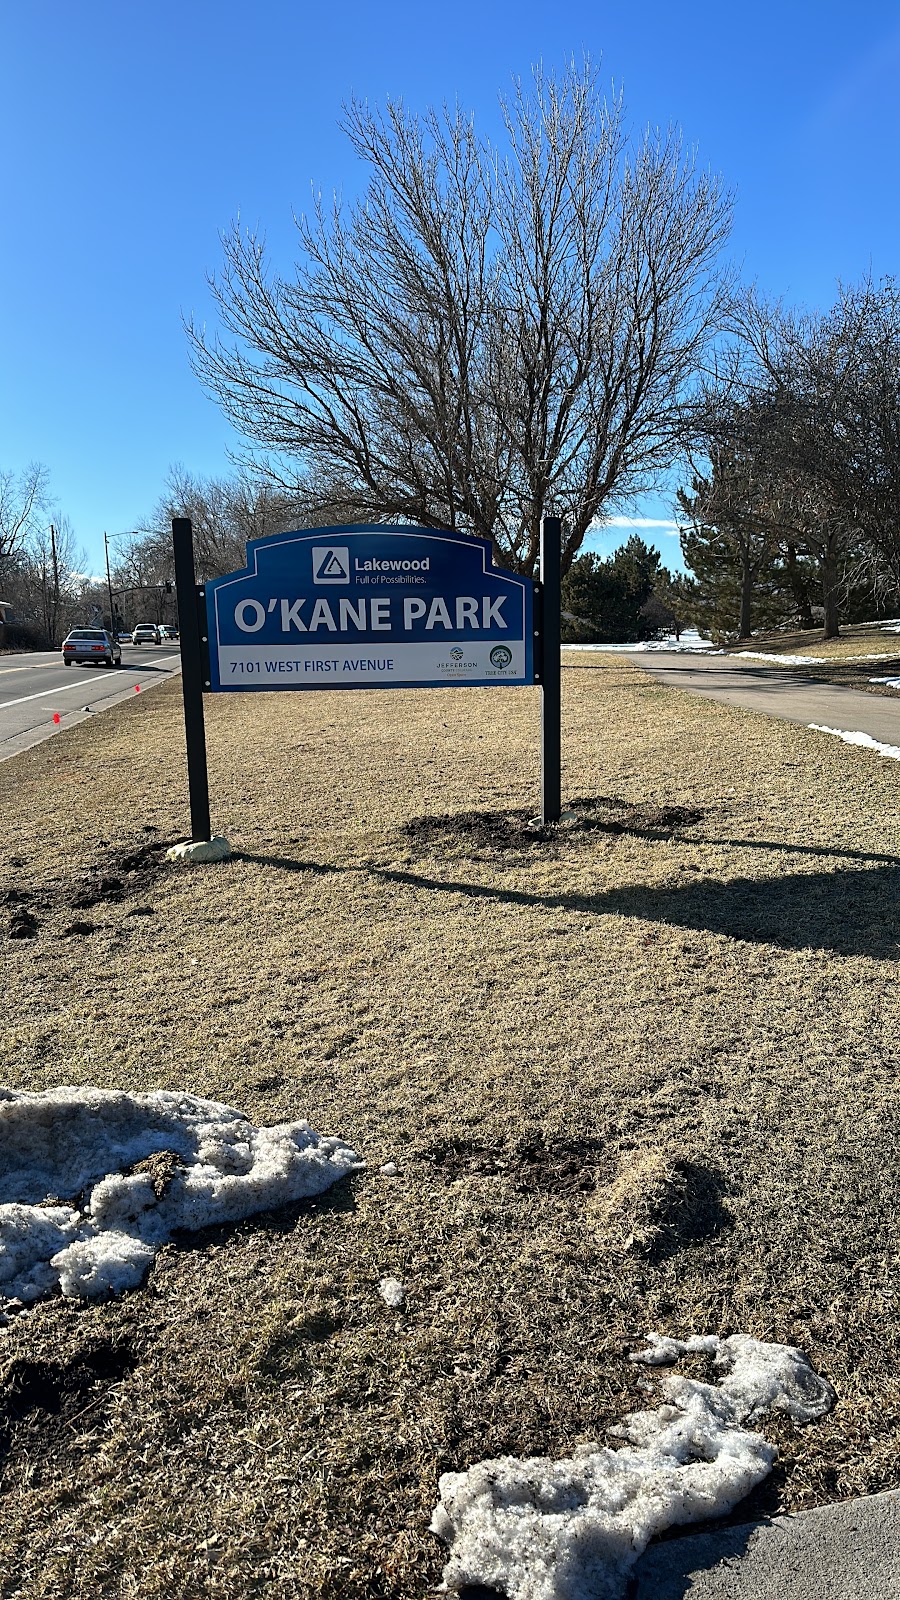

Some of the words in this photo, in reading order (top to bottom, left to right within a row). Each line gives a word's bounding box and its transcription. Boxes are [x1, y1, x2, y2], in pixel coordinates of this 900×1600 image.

[355, 557, 430, 571] Lakewood
[355, 575, 370, 584] Full
[371, 575, 380, 584] of
[380, 574, 427, 584] Possibilities.
[234, 598, 392, 633] O'KANE
[404, 595, 508, 630] PARK
[230, 662, 261, 673] 7101
[265, 661, 300, 673] WEST
[304, 660, 339, 672] FIRST
[342, 659, 394, 671] AVENUE
